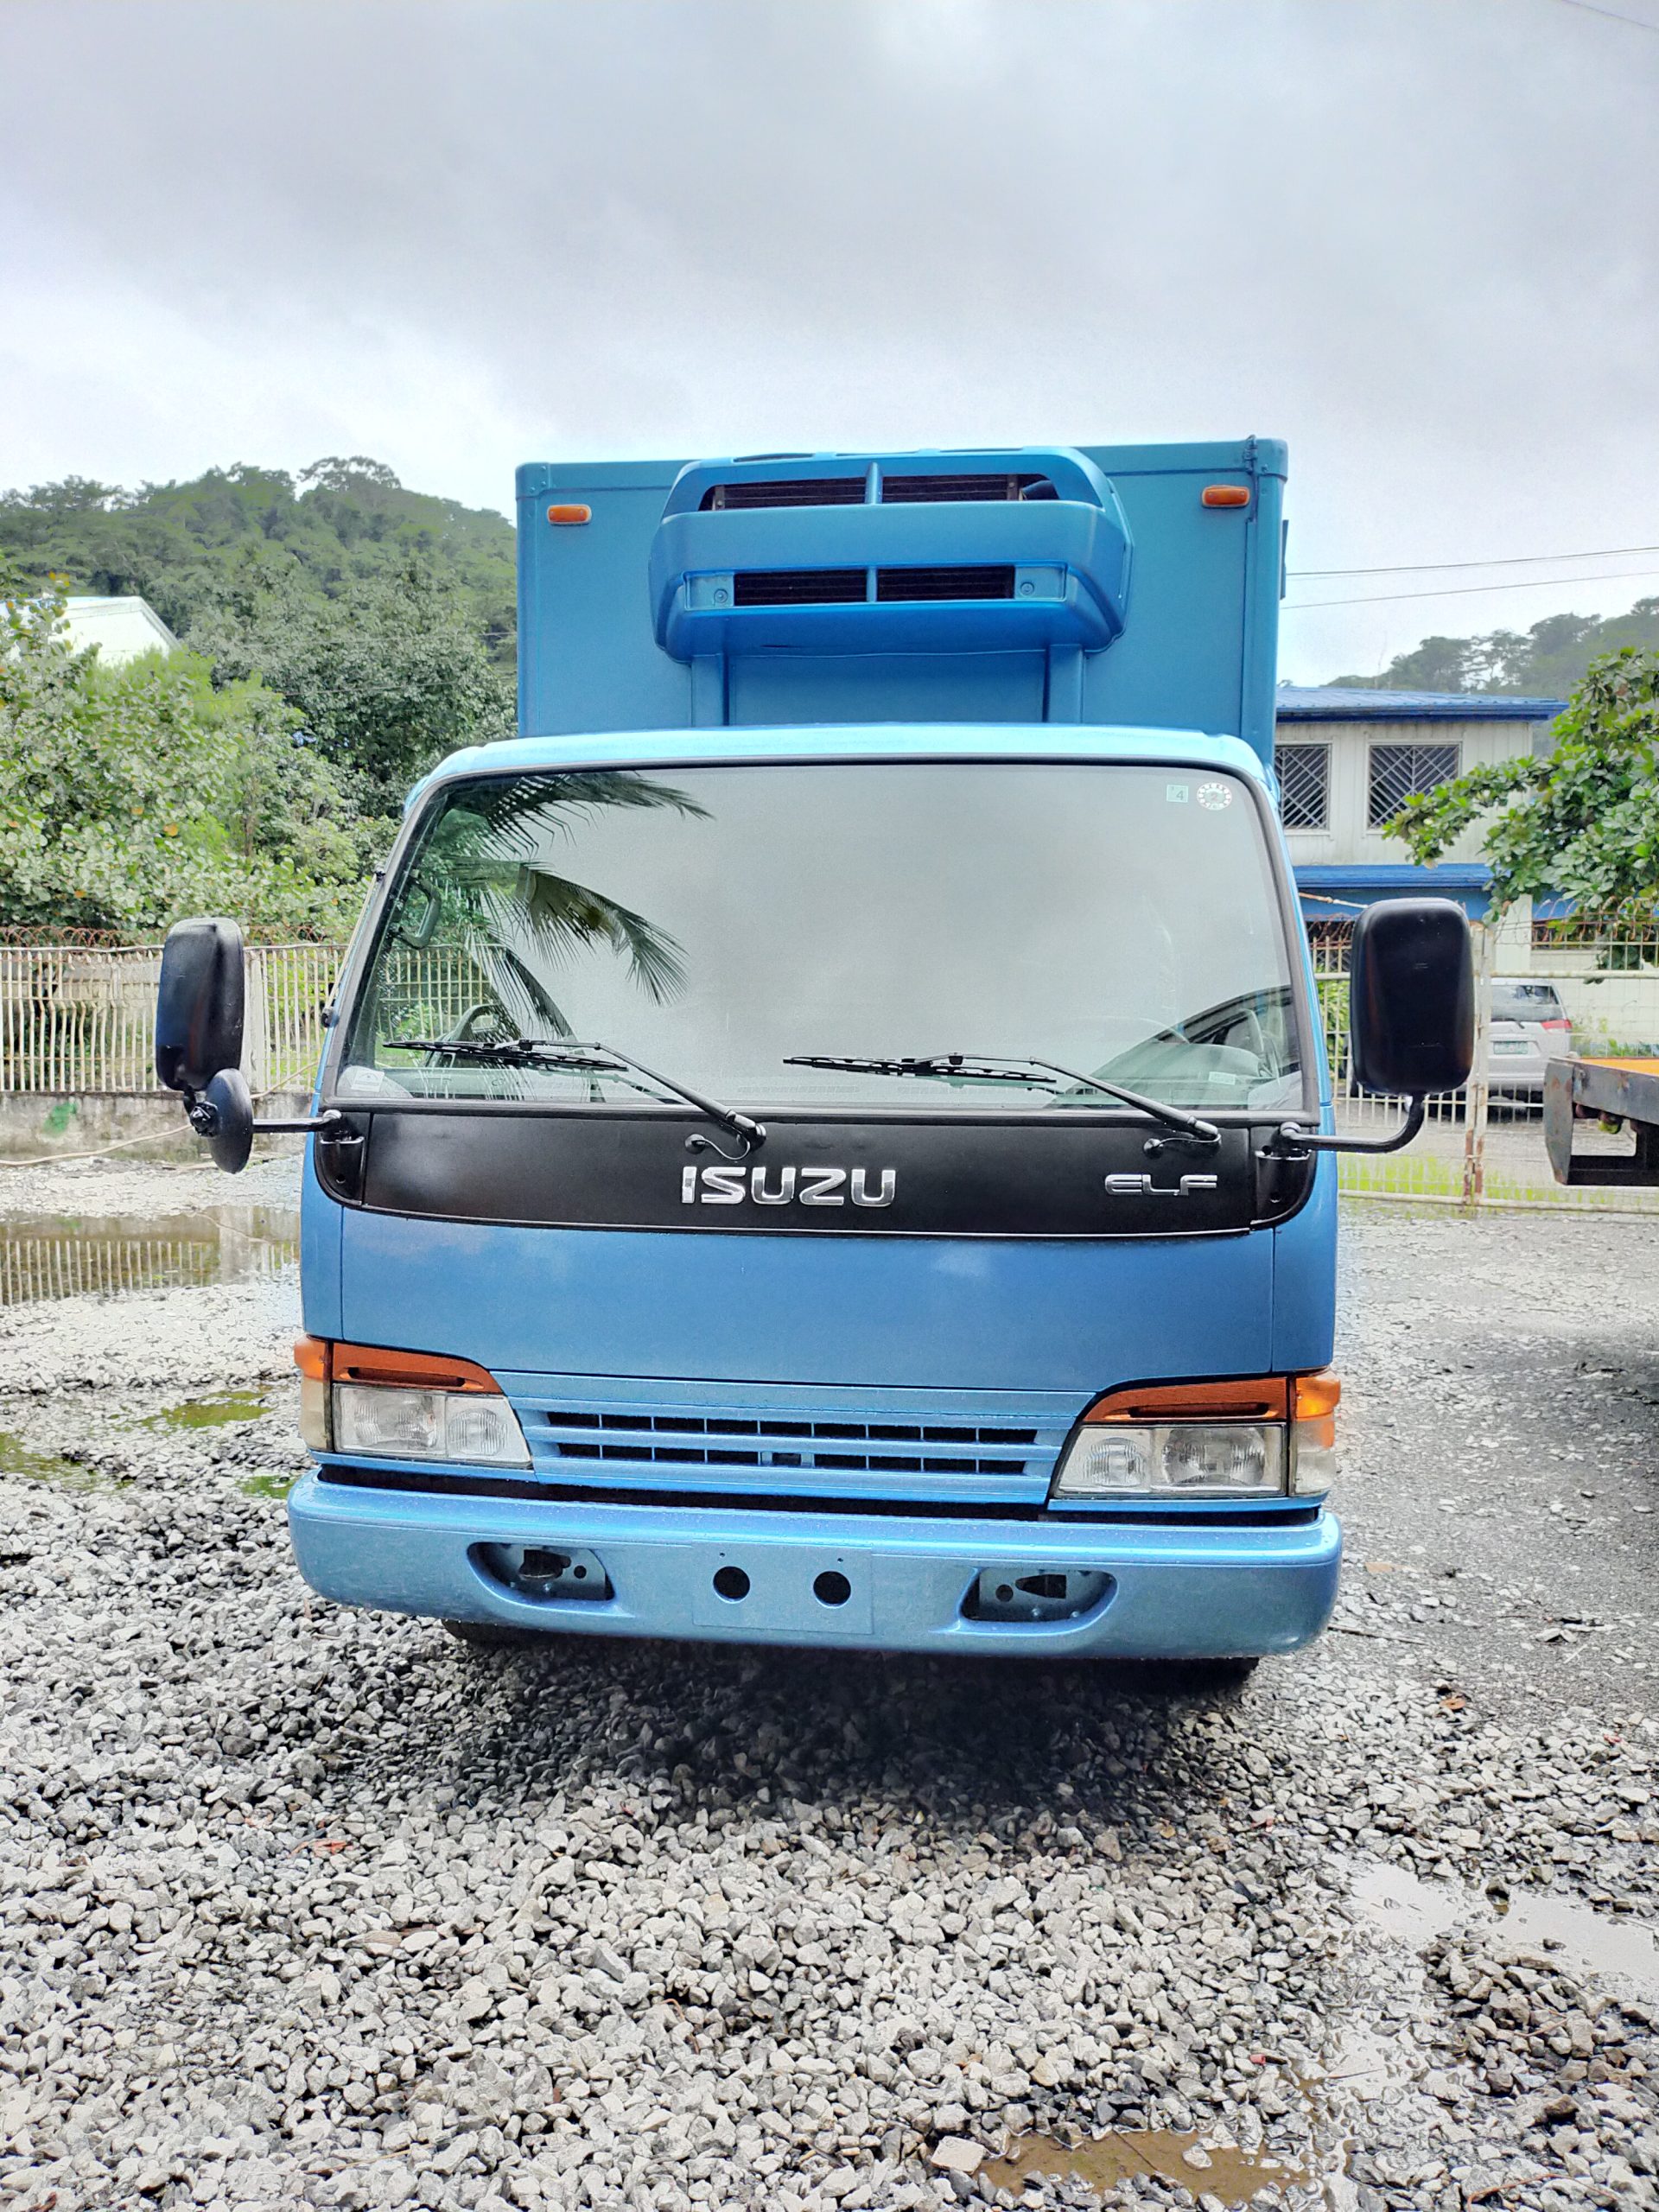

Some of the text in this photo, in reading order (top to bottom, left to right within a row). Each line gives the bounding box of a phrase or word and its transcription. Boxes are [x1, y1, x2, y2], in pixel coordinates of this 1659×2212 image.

[1176, 790, 1184, 801] 4
[682, 1166, 896, 1207] ISUZU
[1105, 1173, 1217, 1196] ELF
